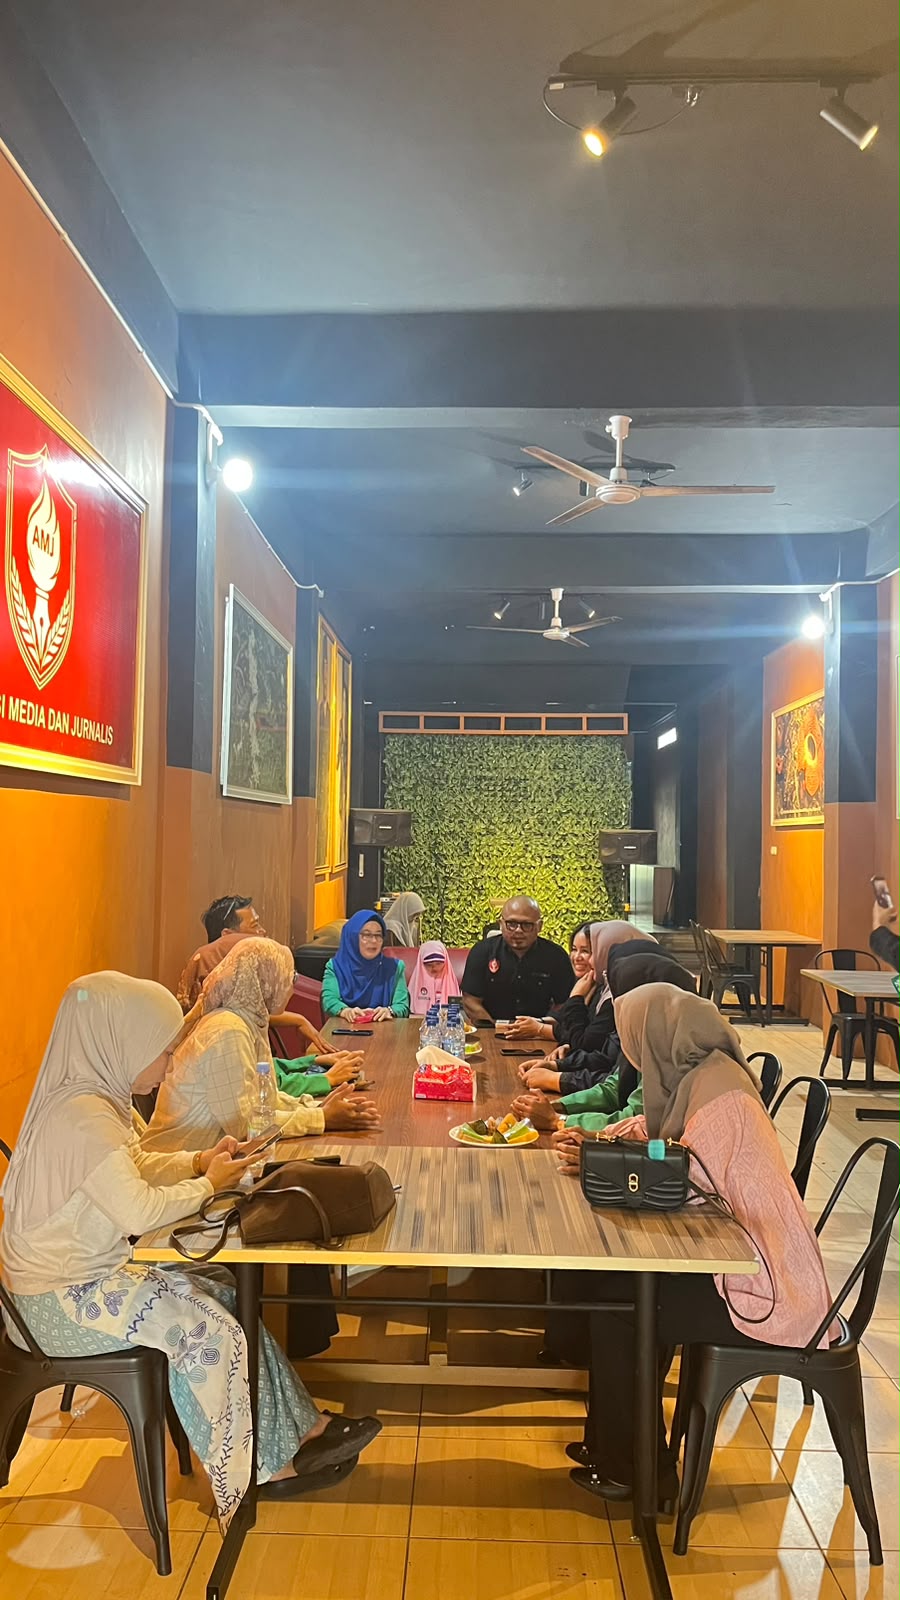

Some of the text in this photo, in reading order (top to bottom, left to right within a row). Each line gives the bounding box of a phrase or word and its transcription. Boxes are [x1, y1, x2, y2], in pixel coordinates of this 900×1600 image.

[32, 524, 55, 557] AMJ
[8, 695, 46, 729] MEDIA
[47, 707, 70, 735] DAN
[70, 715, 114, 746] JURNALIS
